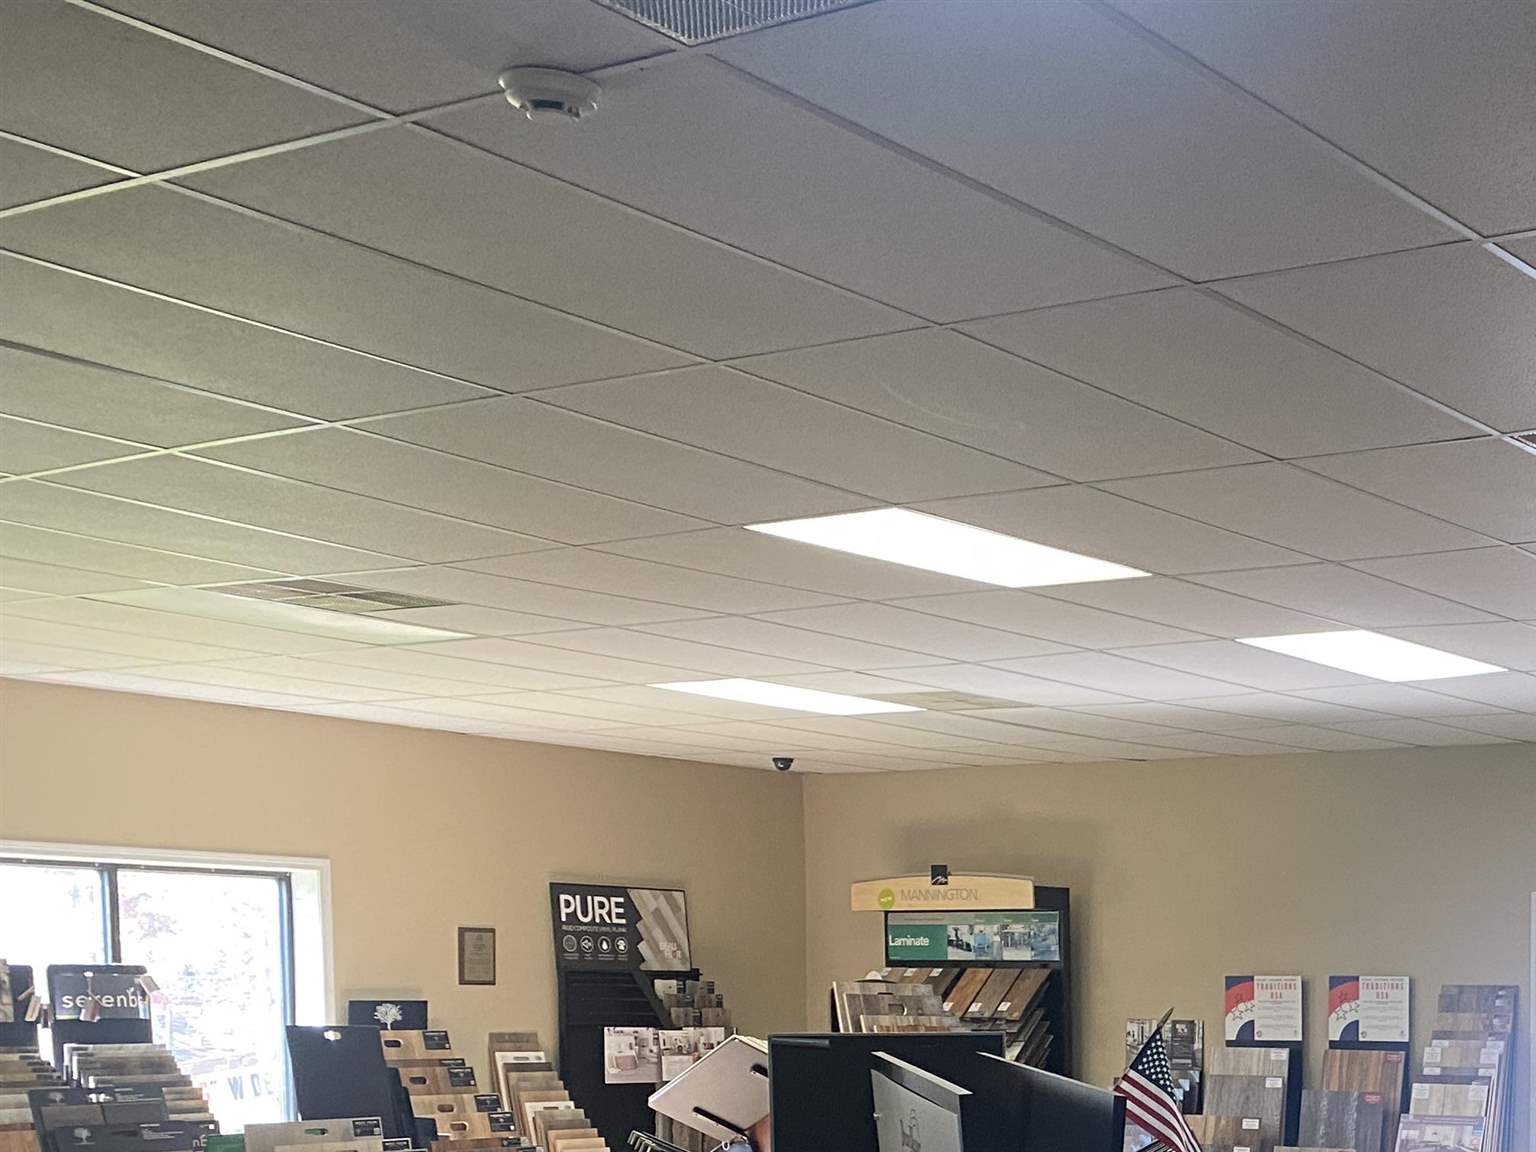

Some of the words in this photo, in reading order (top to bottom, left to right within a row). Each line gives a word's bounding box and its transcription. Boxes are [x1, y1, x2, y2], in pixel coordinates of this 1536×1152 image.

[900, 887, 979, 901] MANNINGTON
[559, 894, 627, 924] PURE
[888, 934, 930, 946] Laminate
